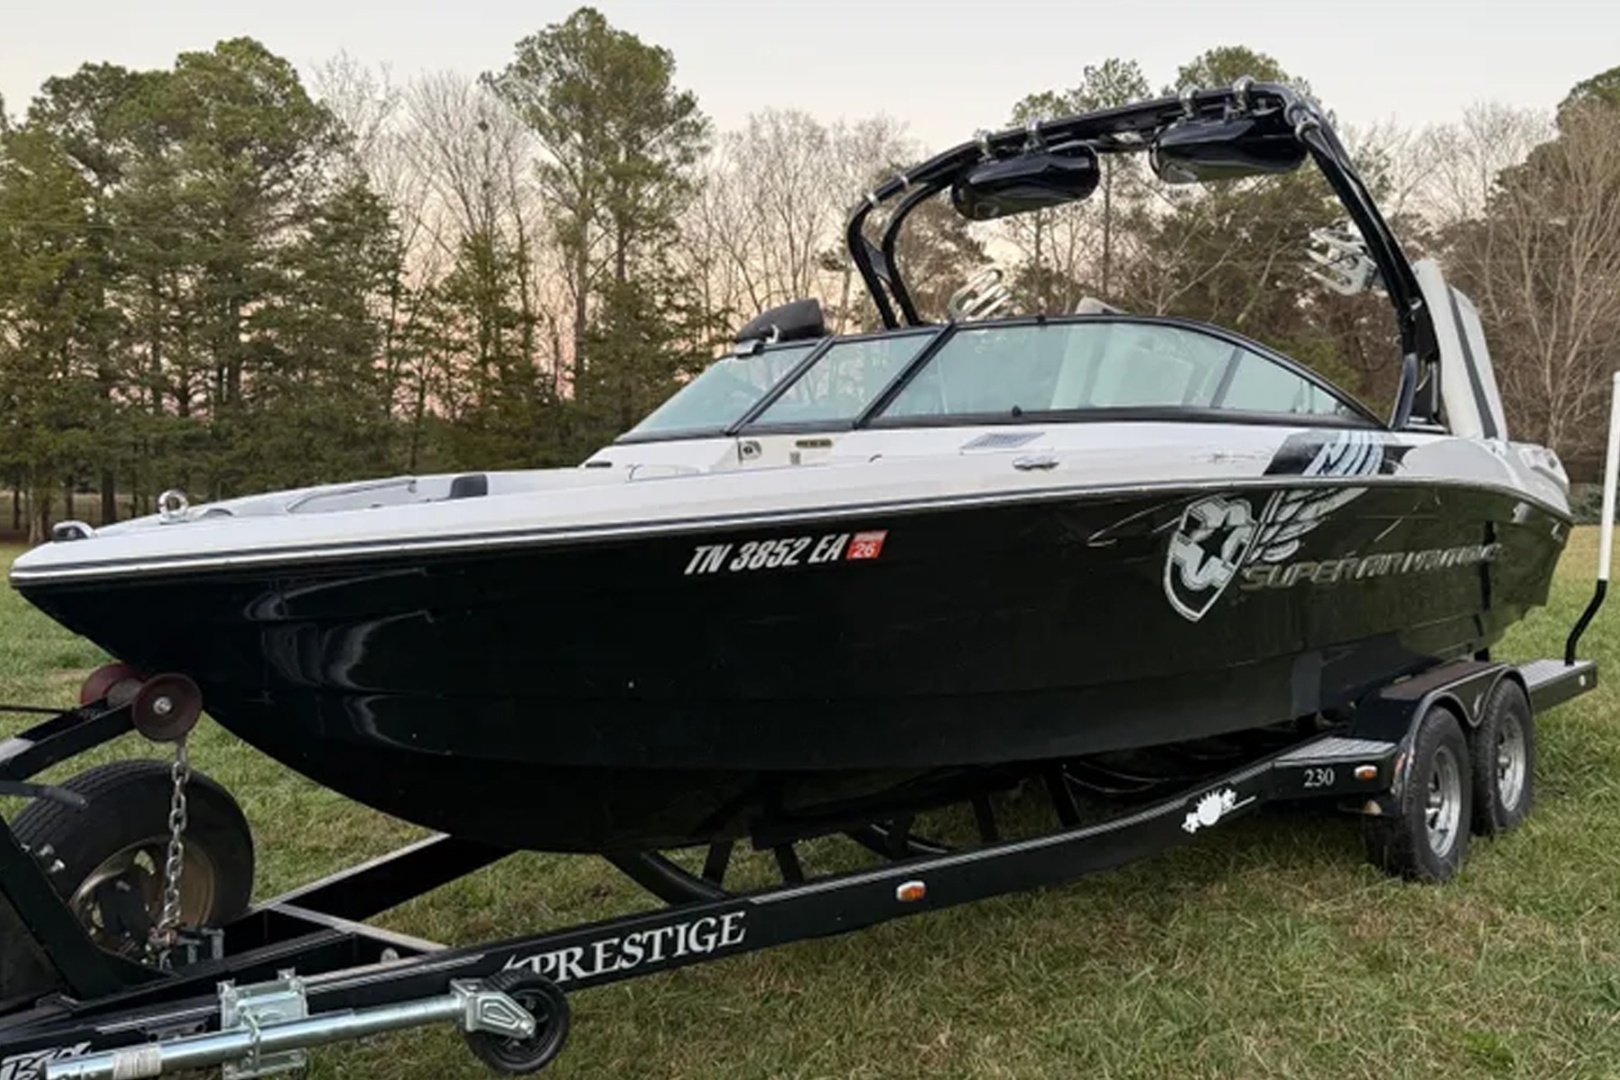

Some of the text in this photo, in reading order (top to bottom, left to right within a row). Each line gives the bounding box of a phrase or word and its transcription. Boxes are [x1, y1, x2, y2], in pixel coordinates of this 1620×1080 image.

[684, 533, 850, 575] TN 3852 EA
[853, 542, 876, 558] 26
[1304, 768, 1335, 787] 230
[505, 911, 746, 983] PRESTIGE
